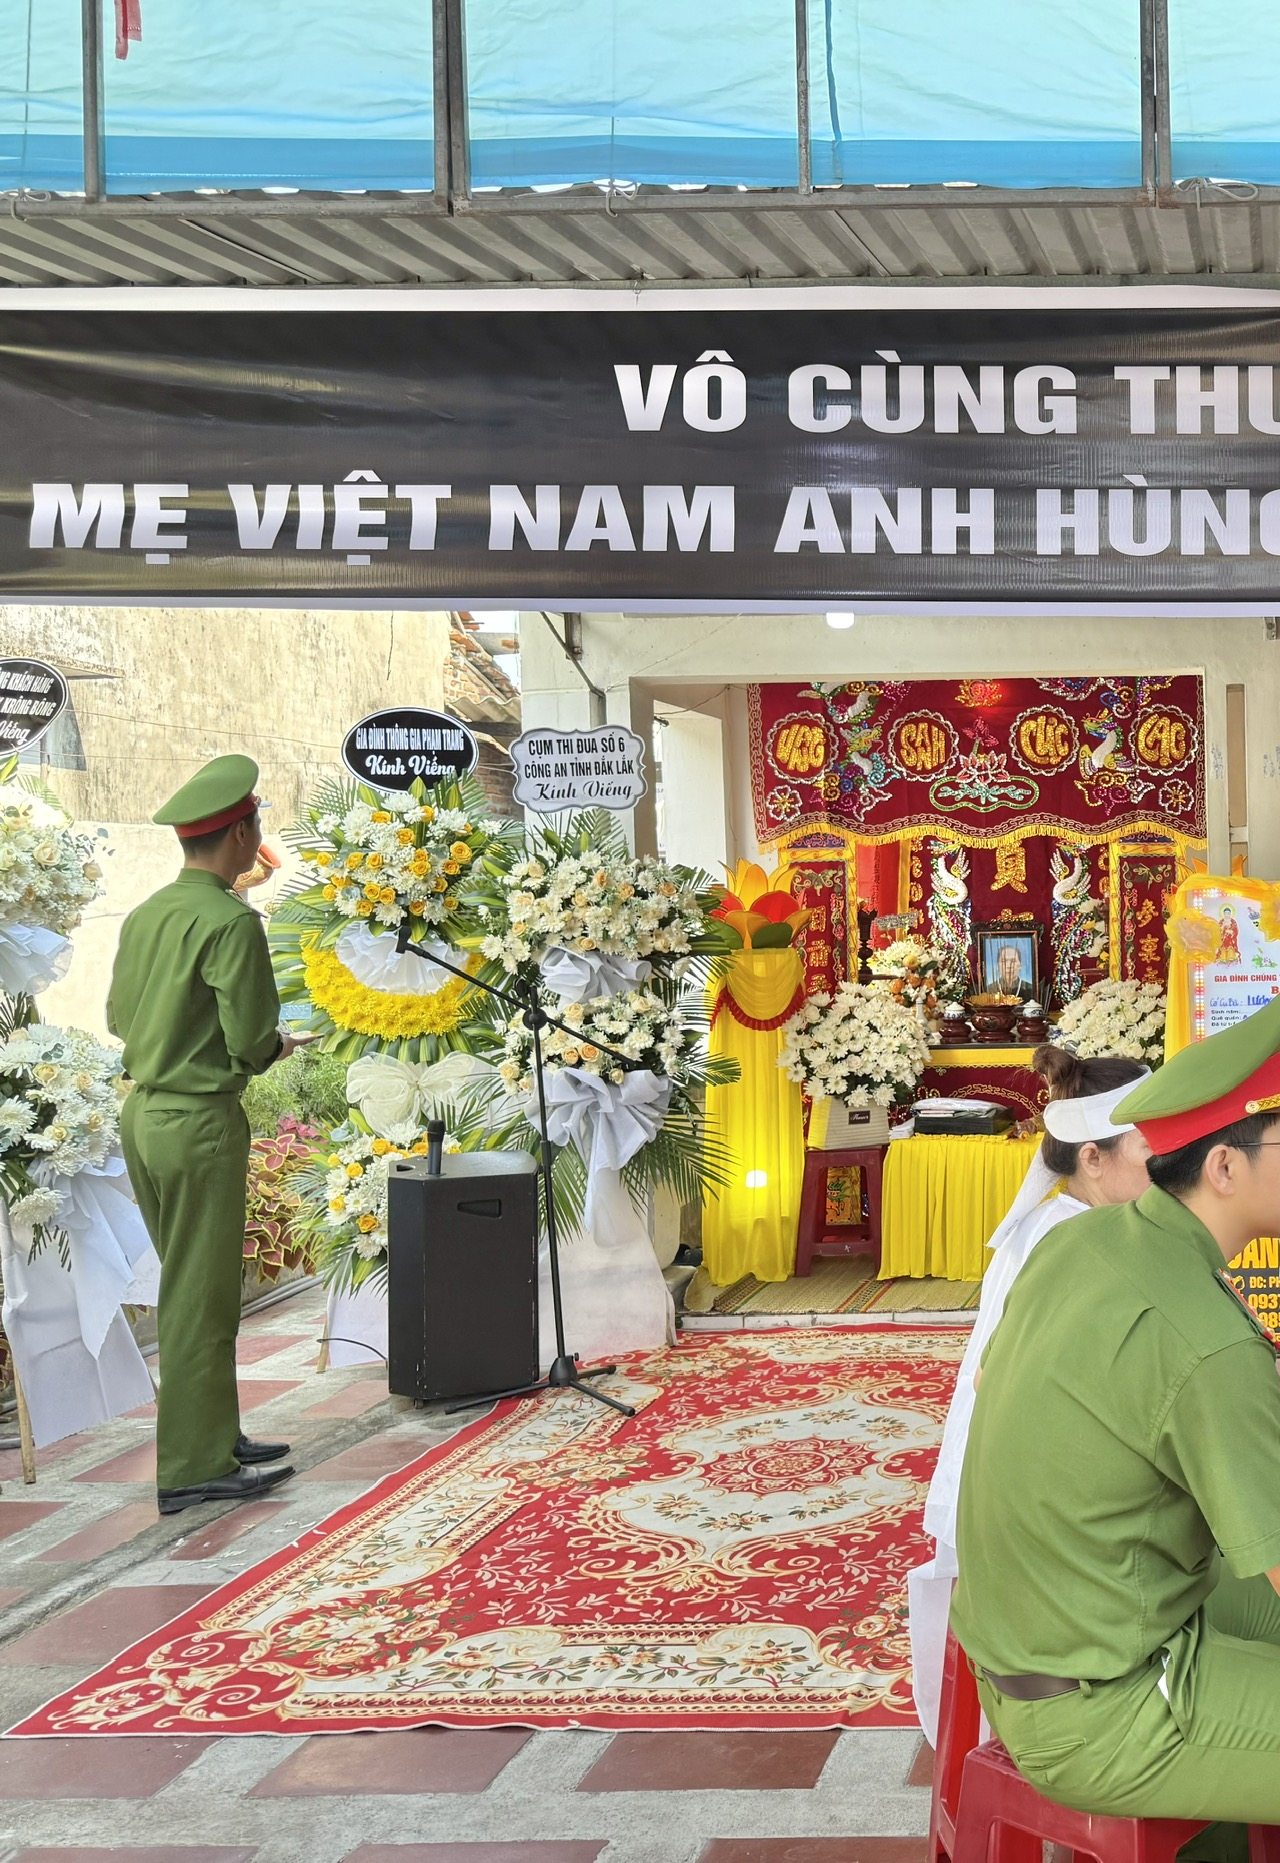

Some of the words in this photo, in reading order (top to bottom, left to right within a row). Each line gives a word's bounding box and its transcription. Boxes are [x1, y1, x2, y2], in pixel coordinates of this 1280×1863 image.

[614, 351, 746, 432] VÔ
[789, 351, 1076, 434] CÙNG
[30, 484, 188, 564] MẸ
[228, 470, 451, 565] VIỆT
[489, 485, 734, 551] NAM
[774, 487, 994, 554] ANH
[356, 728, 368, 750] GIA
[368, 723, 386, 750] ĐÌNH
[386, 723, 409, 750] THÔNG
[409, 728, 421, 750] GIA
[442, 729, 464, 751] TRANG
[528, 739, 553, 759] CỤM
[556, 739, 573, 755] THI
[577, 737, 598, 754] ĐUA
[601, 731, 615, 752] SỐ
[618, 737, 625, 752] 6
[365, 754, 406, 775] Kính
[408, 752, 456, 776] Viếng
[524, 760, 551, 779] CÔNG
[554, 763, 567, 777] AN
[570, 757, 592, 777] TỈNH
[594, 755, 614, 775] ĐẮK
[616, 754, 634, 774] LẮK
[583, 781, 632, 800] Viếng
[1230, 974, 1248, 982] ĐÌNH
[1251, 973, 1277, 981] CHÚNG
[1249, 1276, 1266, 1288] ĐC:
